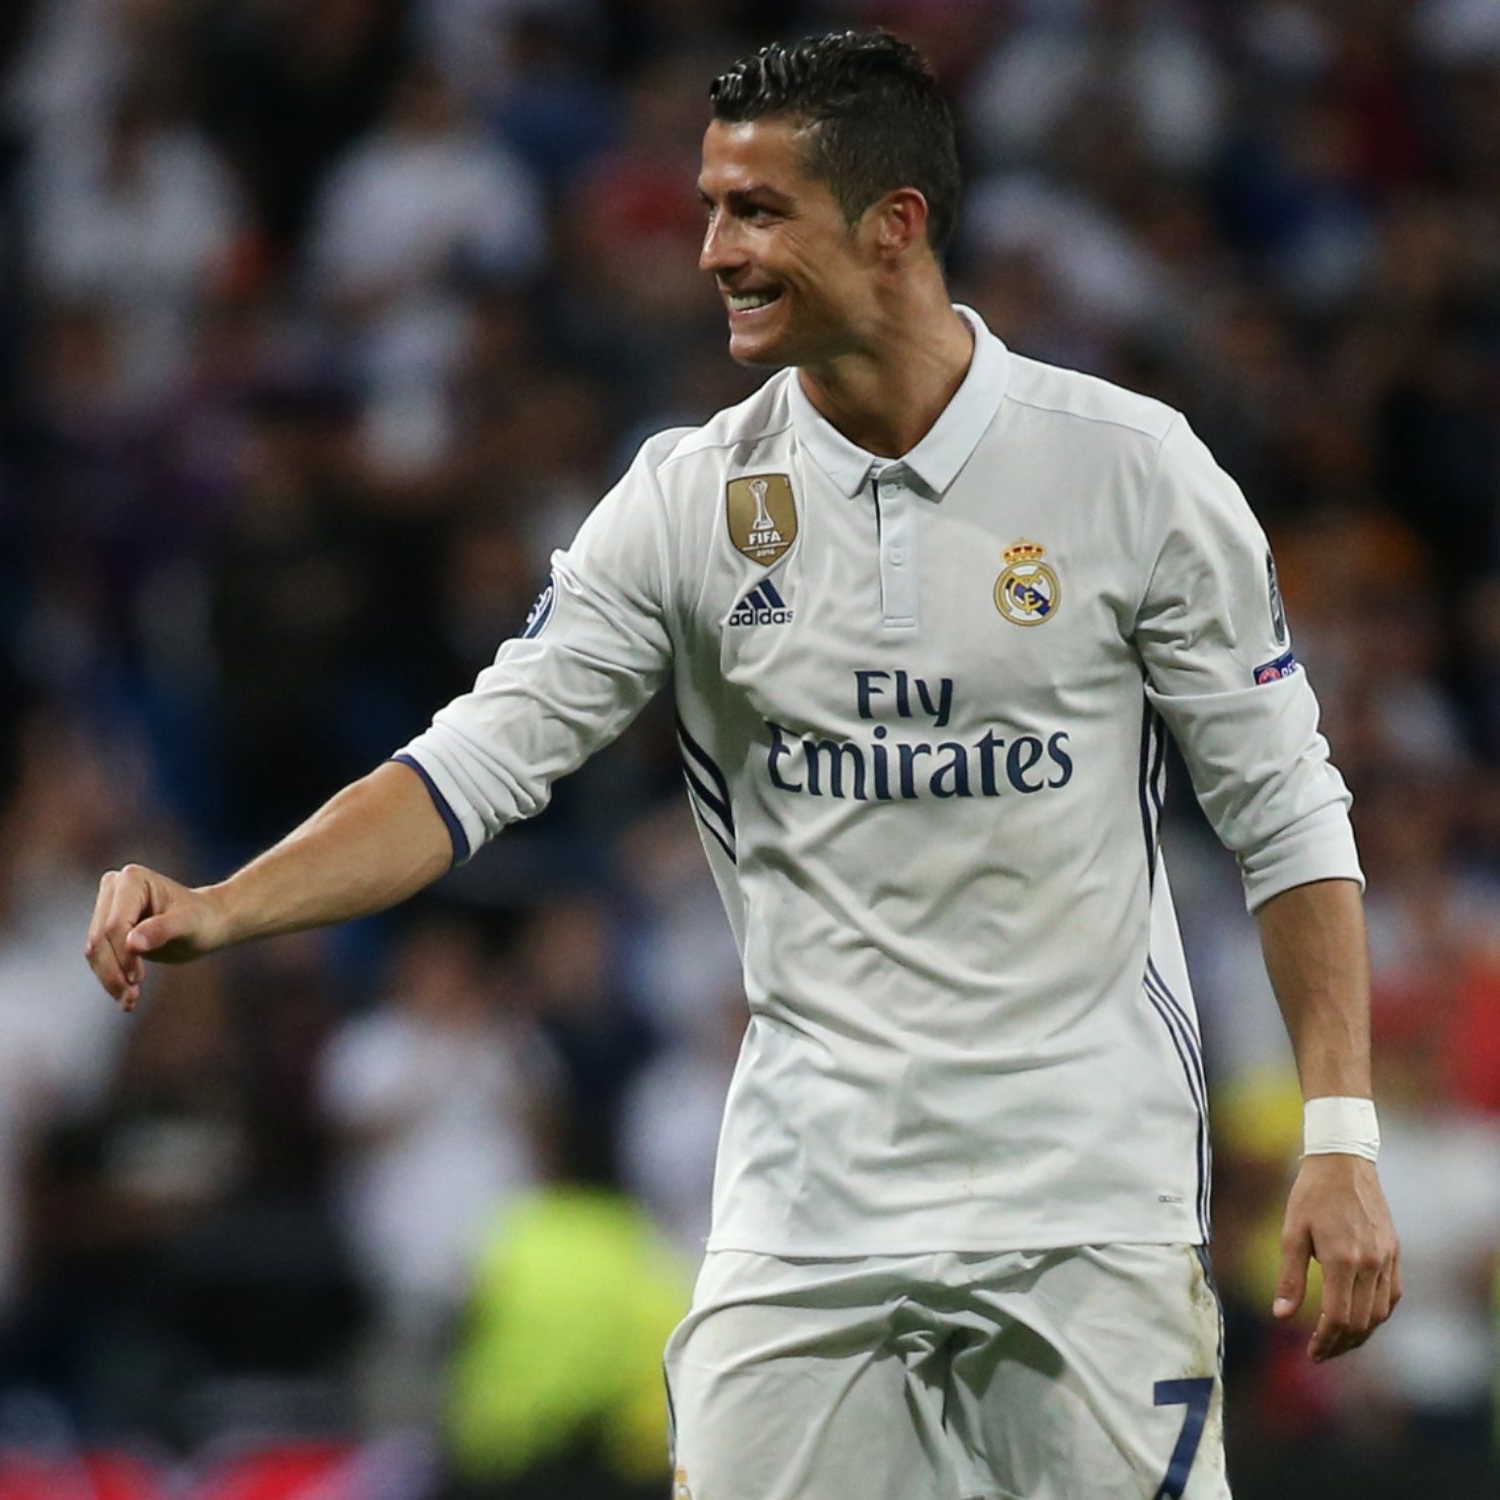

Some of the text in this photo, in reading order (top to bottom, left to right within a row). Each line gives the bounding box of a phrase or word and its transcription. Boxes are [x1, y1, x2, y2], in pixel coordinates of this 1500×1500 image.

[749, 531, 781, 545] FIFA
[729, 608, 793, 626] adidas
[854, 670, 953, 727] Fly
[764, 720, 1073, 801] Emirates
[1153, 1377, 1215, 1500] 7
